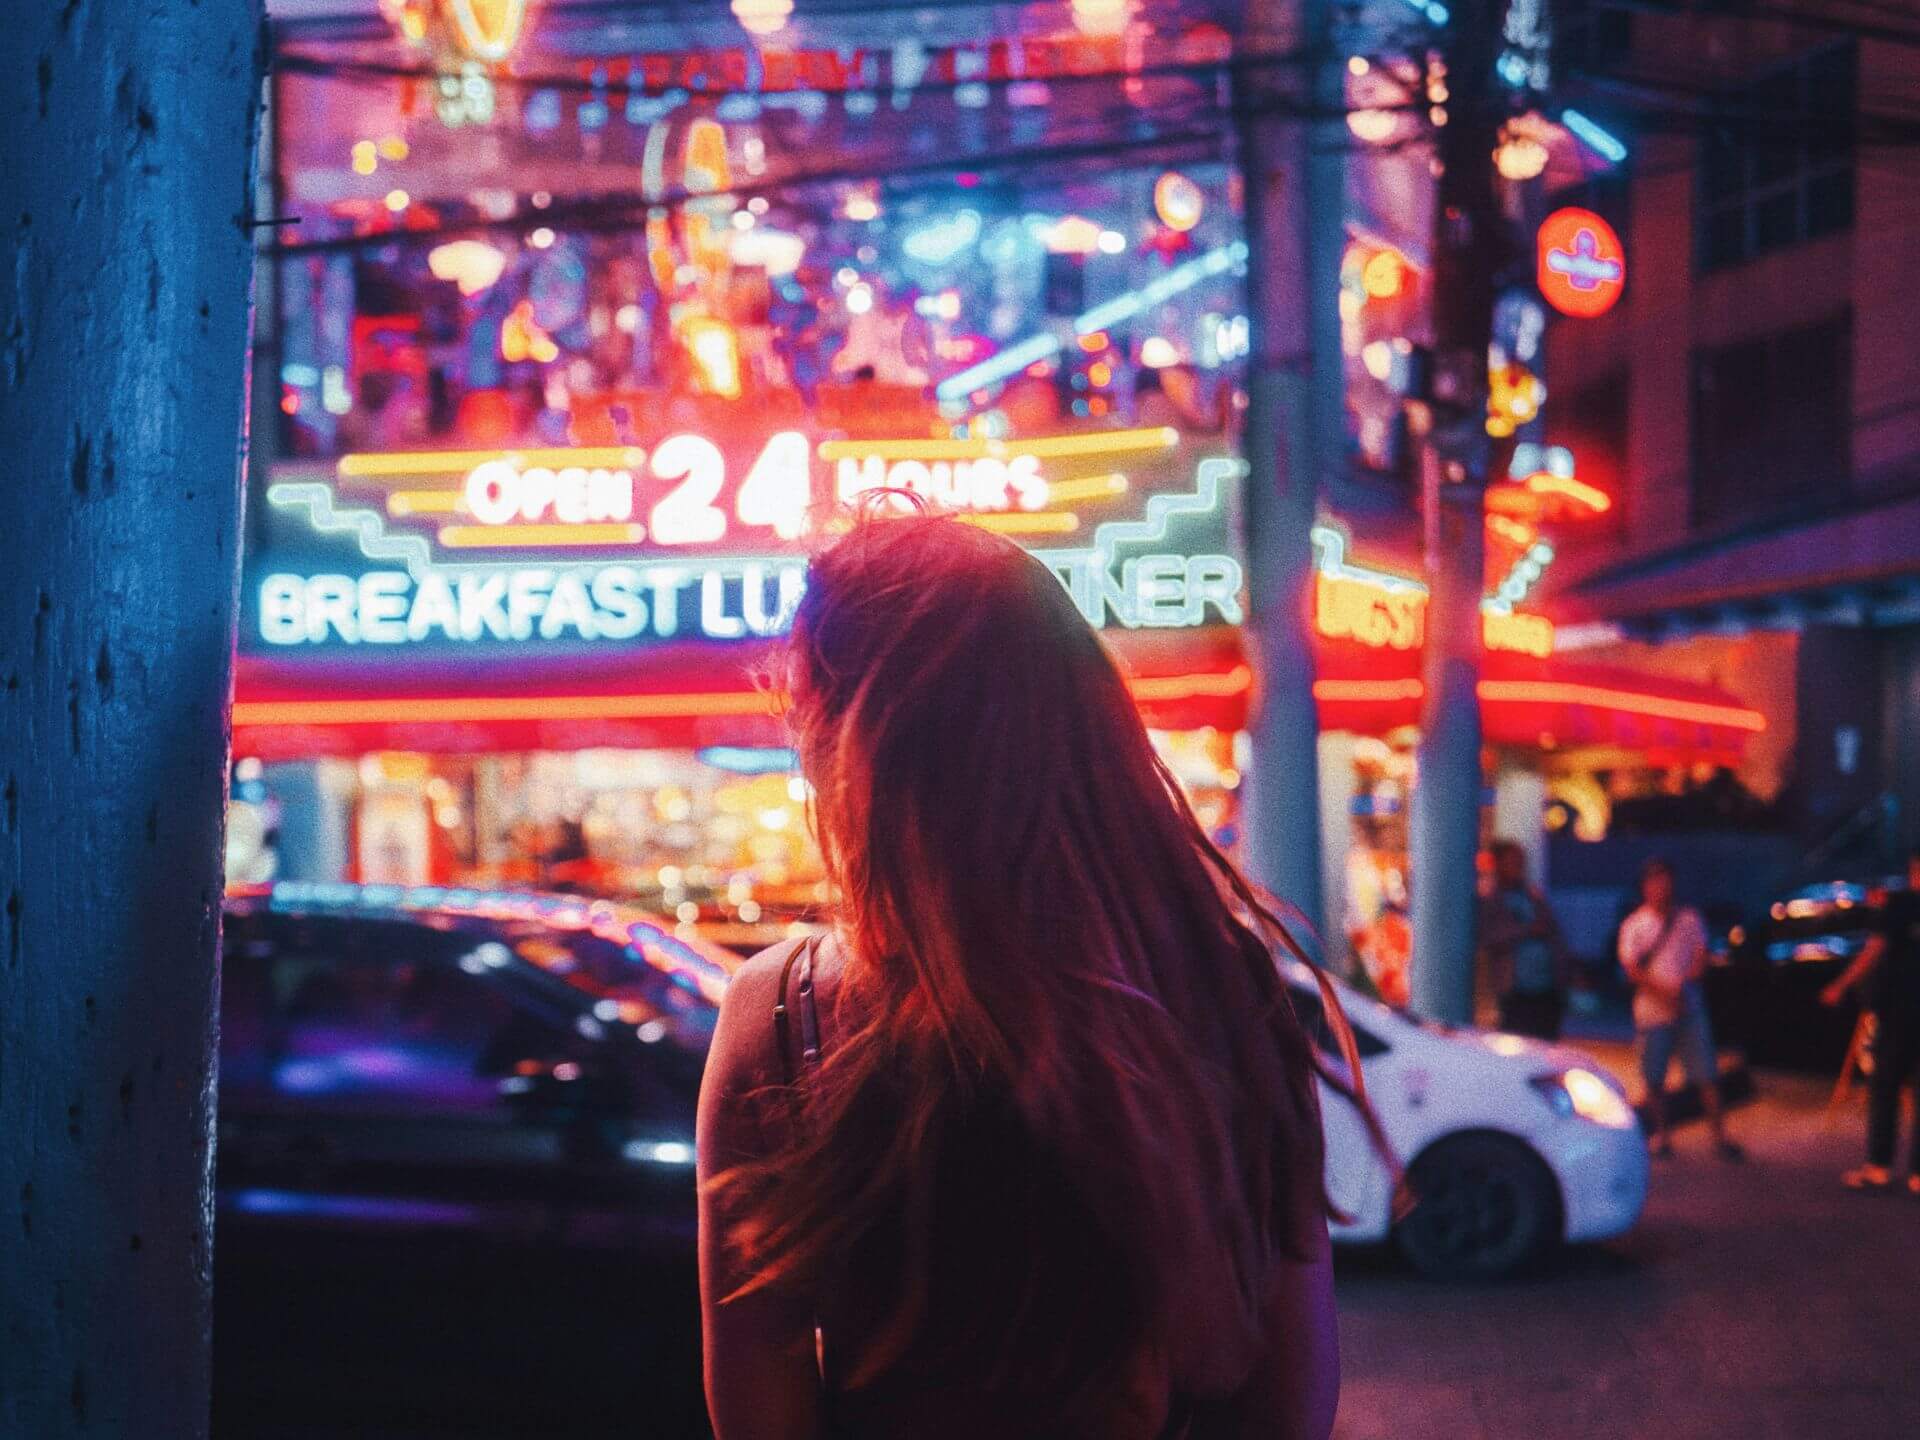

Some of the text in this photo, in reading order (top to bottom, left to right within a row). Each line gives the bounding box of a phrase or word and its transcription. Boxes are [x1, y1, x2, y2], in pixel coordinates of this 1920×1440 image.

[465, 432, 1048, 544] OPEN 24 HOURS
[260, 567, 685, 643] BREAKFAST
[701, 565, 807, 637] LU
